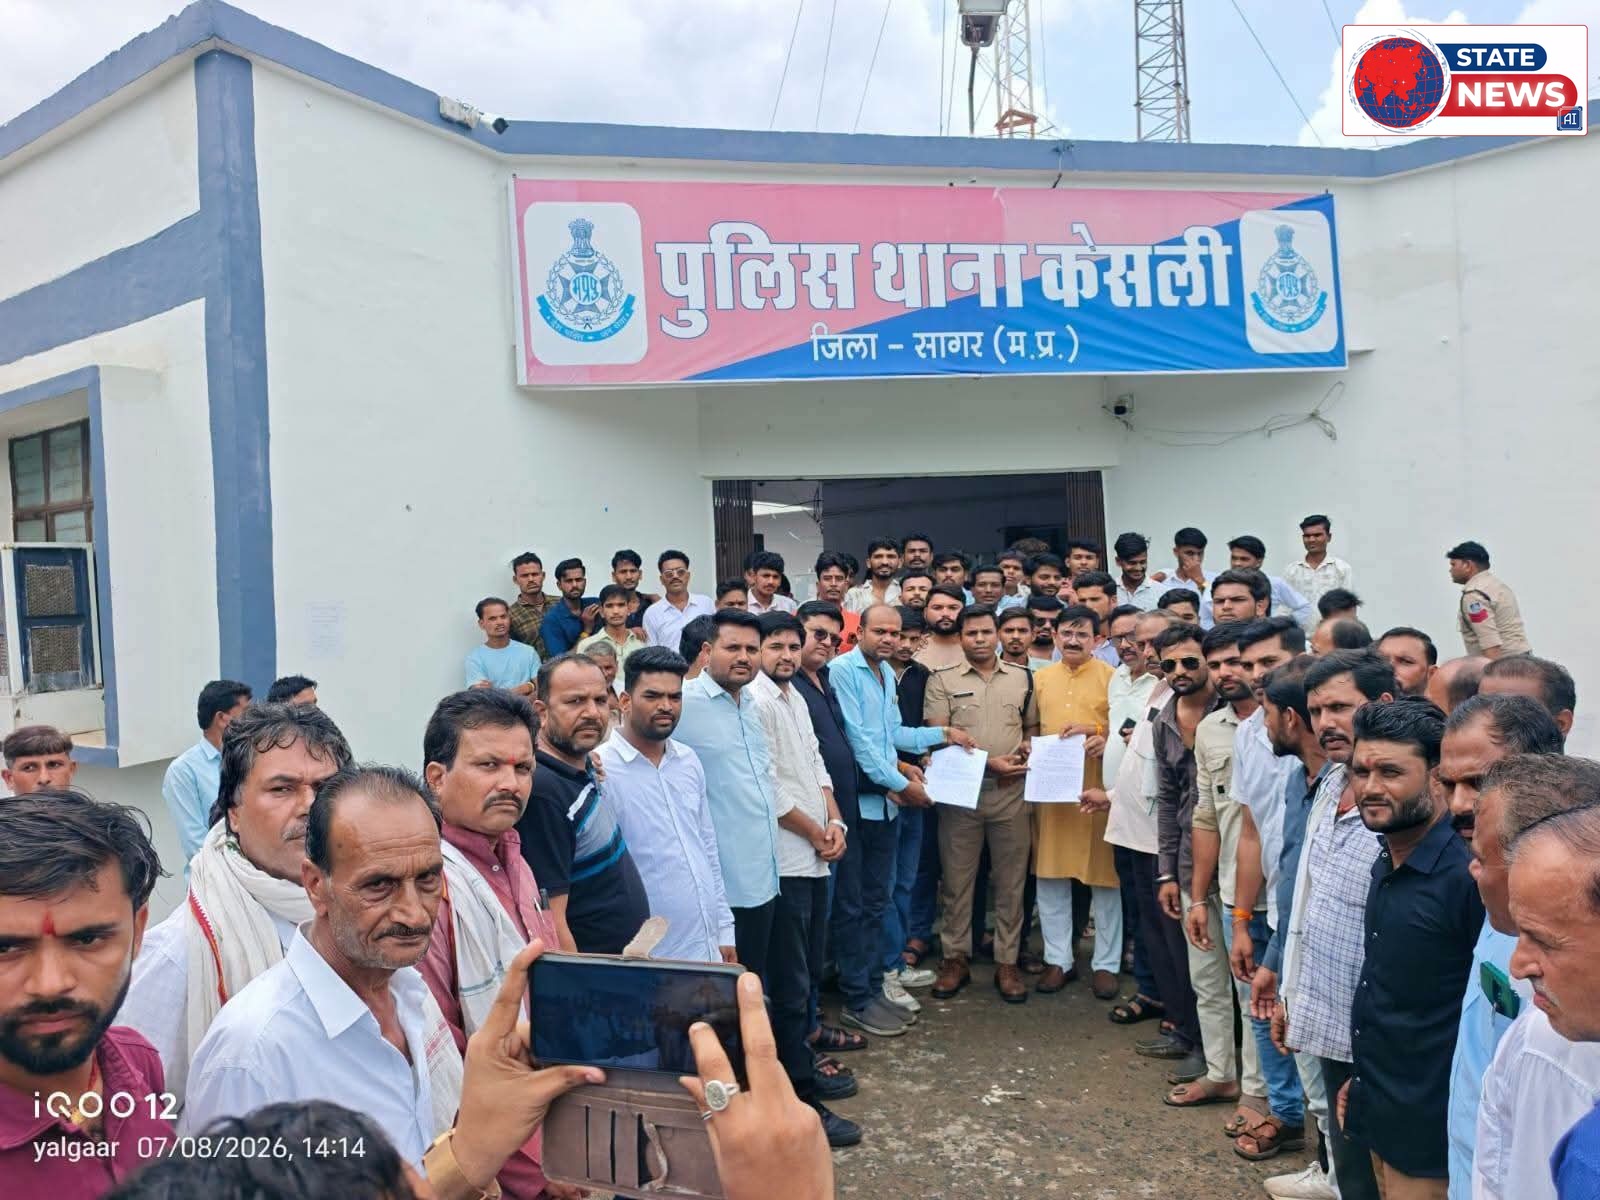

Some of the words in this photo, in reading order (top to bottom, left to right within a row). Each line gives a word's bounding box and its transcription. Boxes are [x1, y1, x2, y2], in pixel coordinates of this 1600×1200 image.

[655, 220, 860, 339] पुलिस
[872, 241, 1028, 308] थाना
[1035, 222, 1233, 308] केसली
[810, 321, 879, 361] जिला
[912, 331, 984, 358] सागर
[993, 324, 1080, 364] (म.प्र.)
